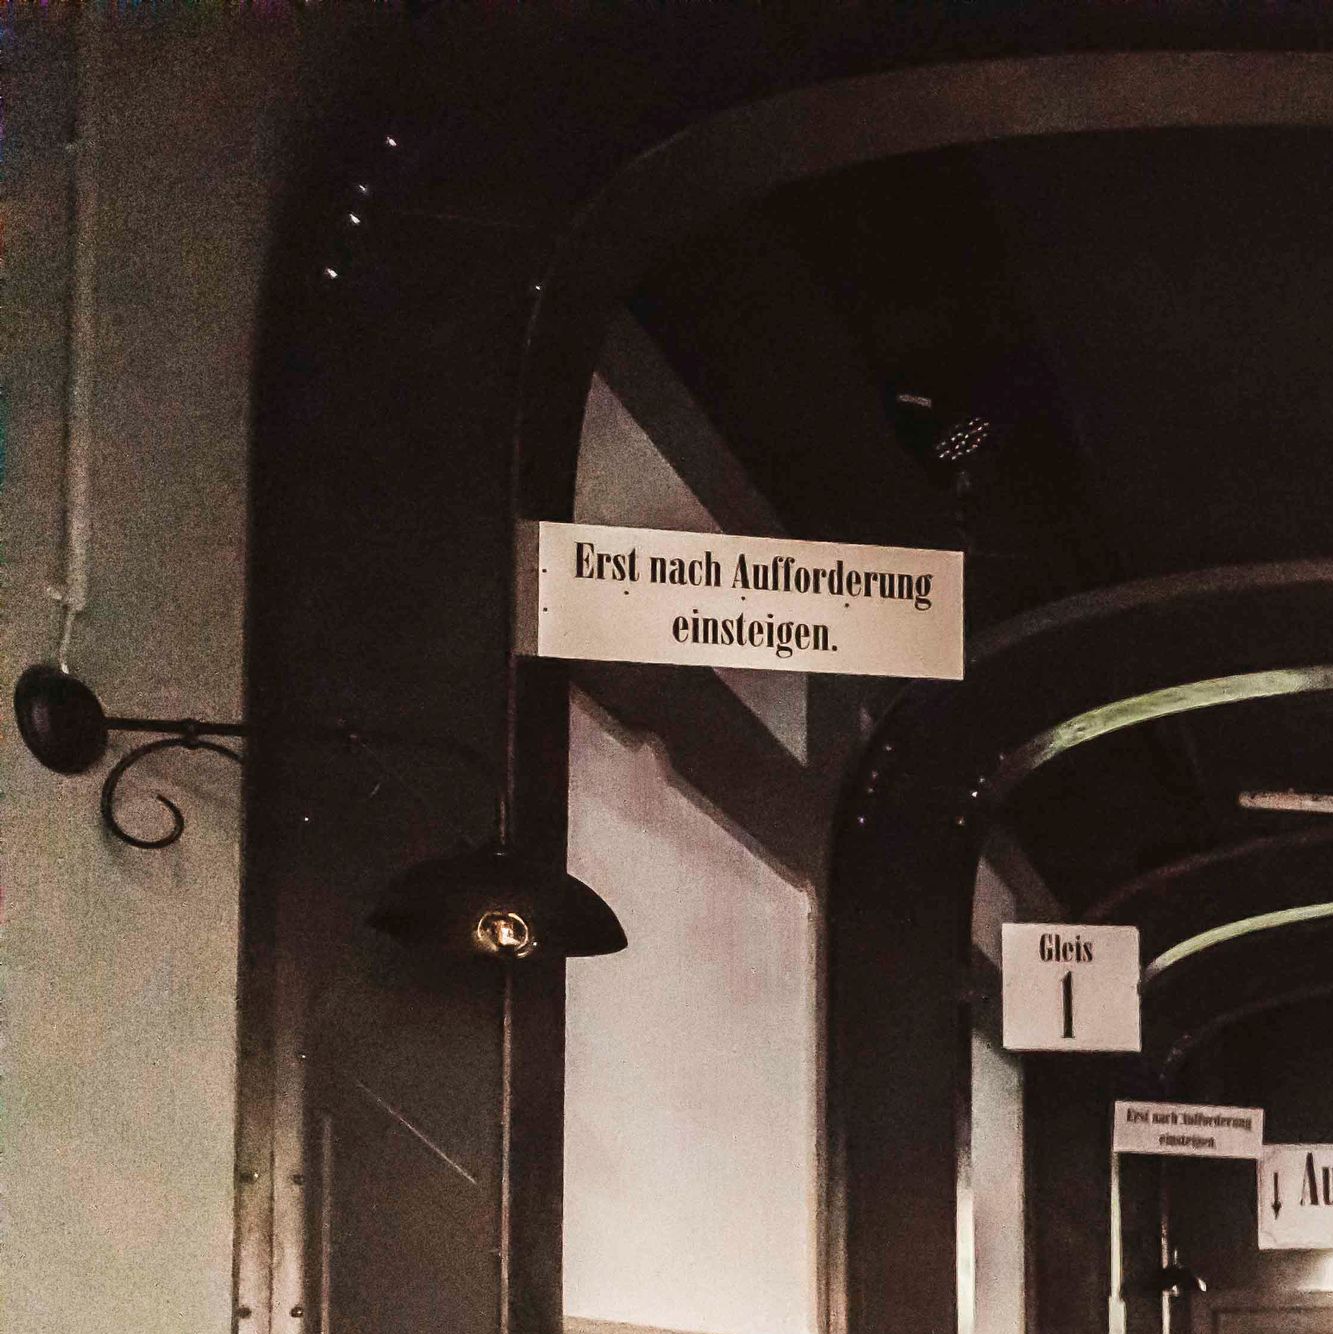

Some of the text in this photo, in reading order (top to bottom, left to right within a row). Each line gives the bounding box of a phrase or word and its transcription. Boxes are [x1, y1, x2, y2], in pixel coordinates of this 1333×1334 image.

[575, 542, 932, 611] Erst nach Aufforderung
[672, 608, 838, 658] einsteigen.
[1040, 933, 1093, 962] Gleis
[1061, 970, 1076, 1038] 1
